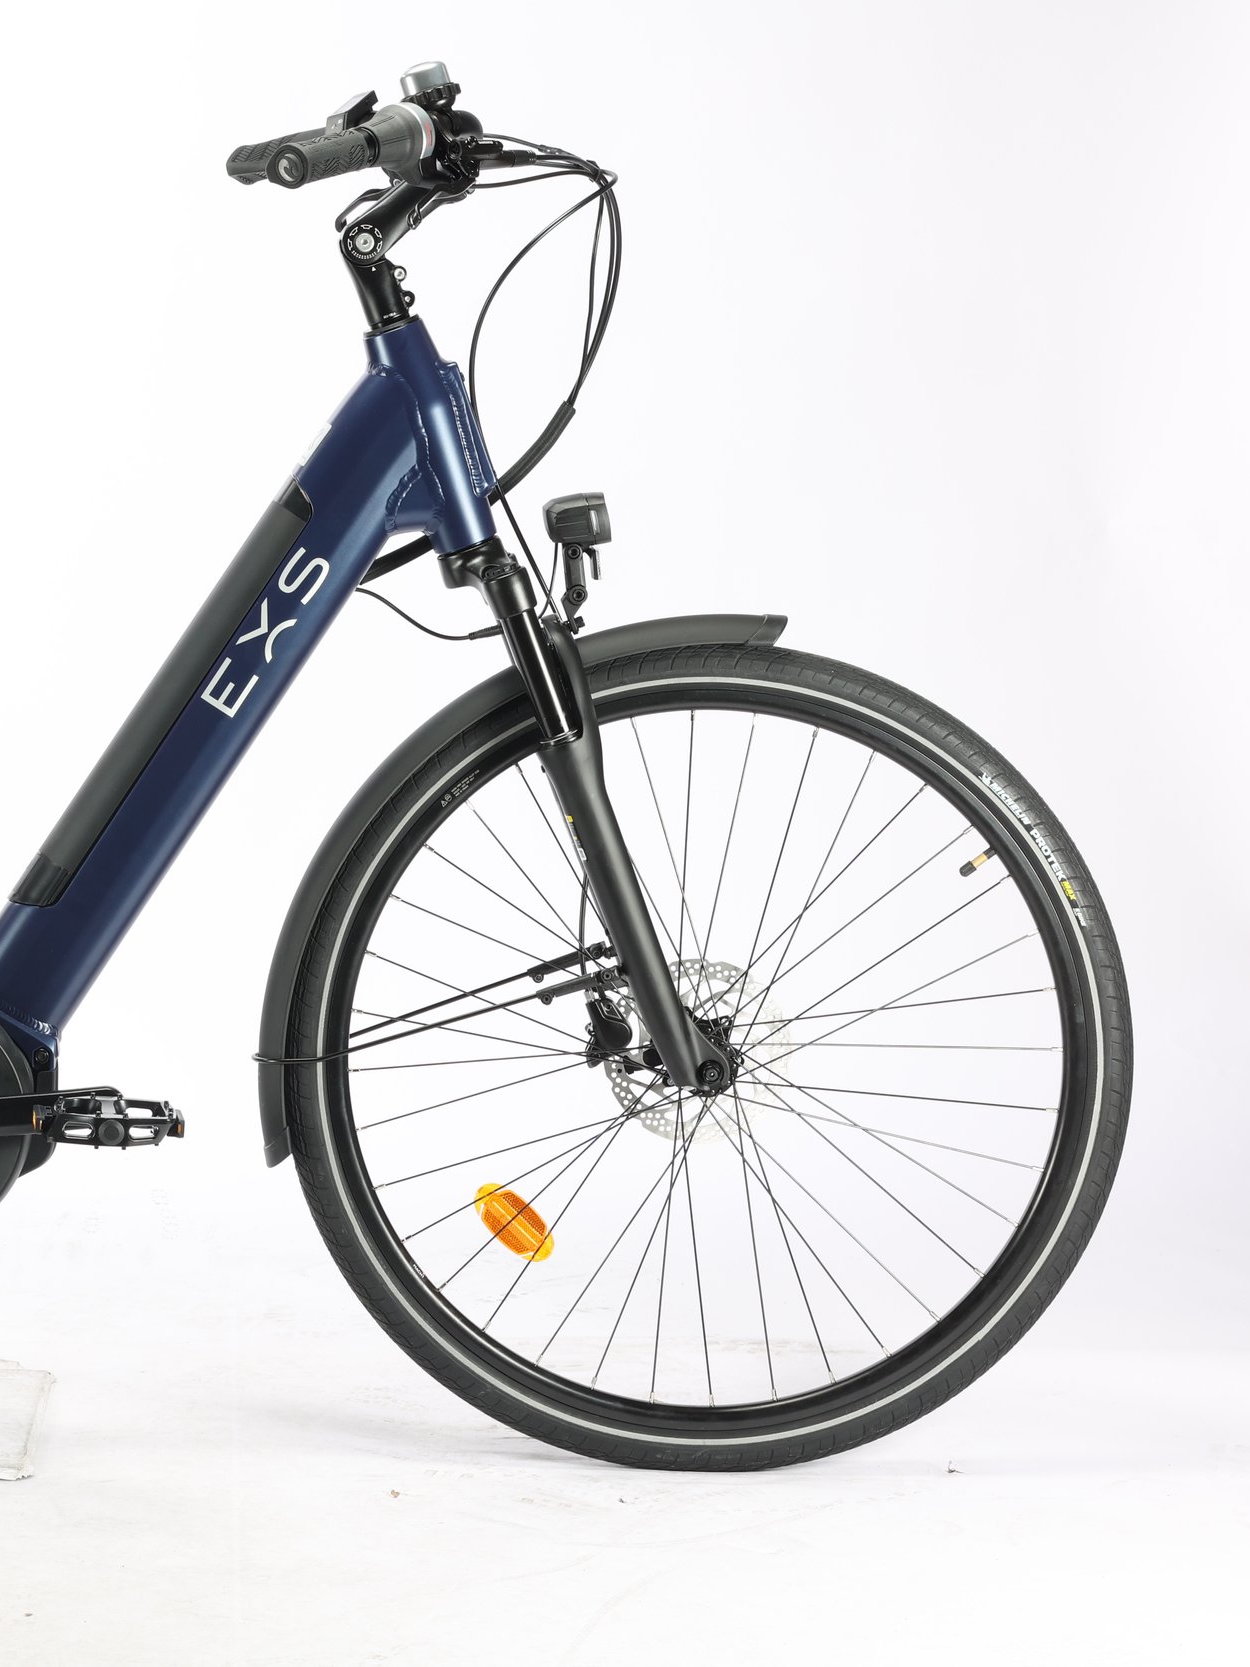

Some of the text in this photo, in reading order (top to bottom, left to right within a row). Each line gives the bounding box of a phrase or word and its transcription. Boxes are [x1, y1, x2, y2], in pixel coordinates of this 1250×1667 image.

[200, 546, 330, 718] EXS
[990, 782, 1031, 825] MICHELIN
[1029, 828, 1068, 881] PROTEK
